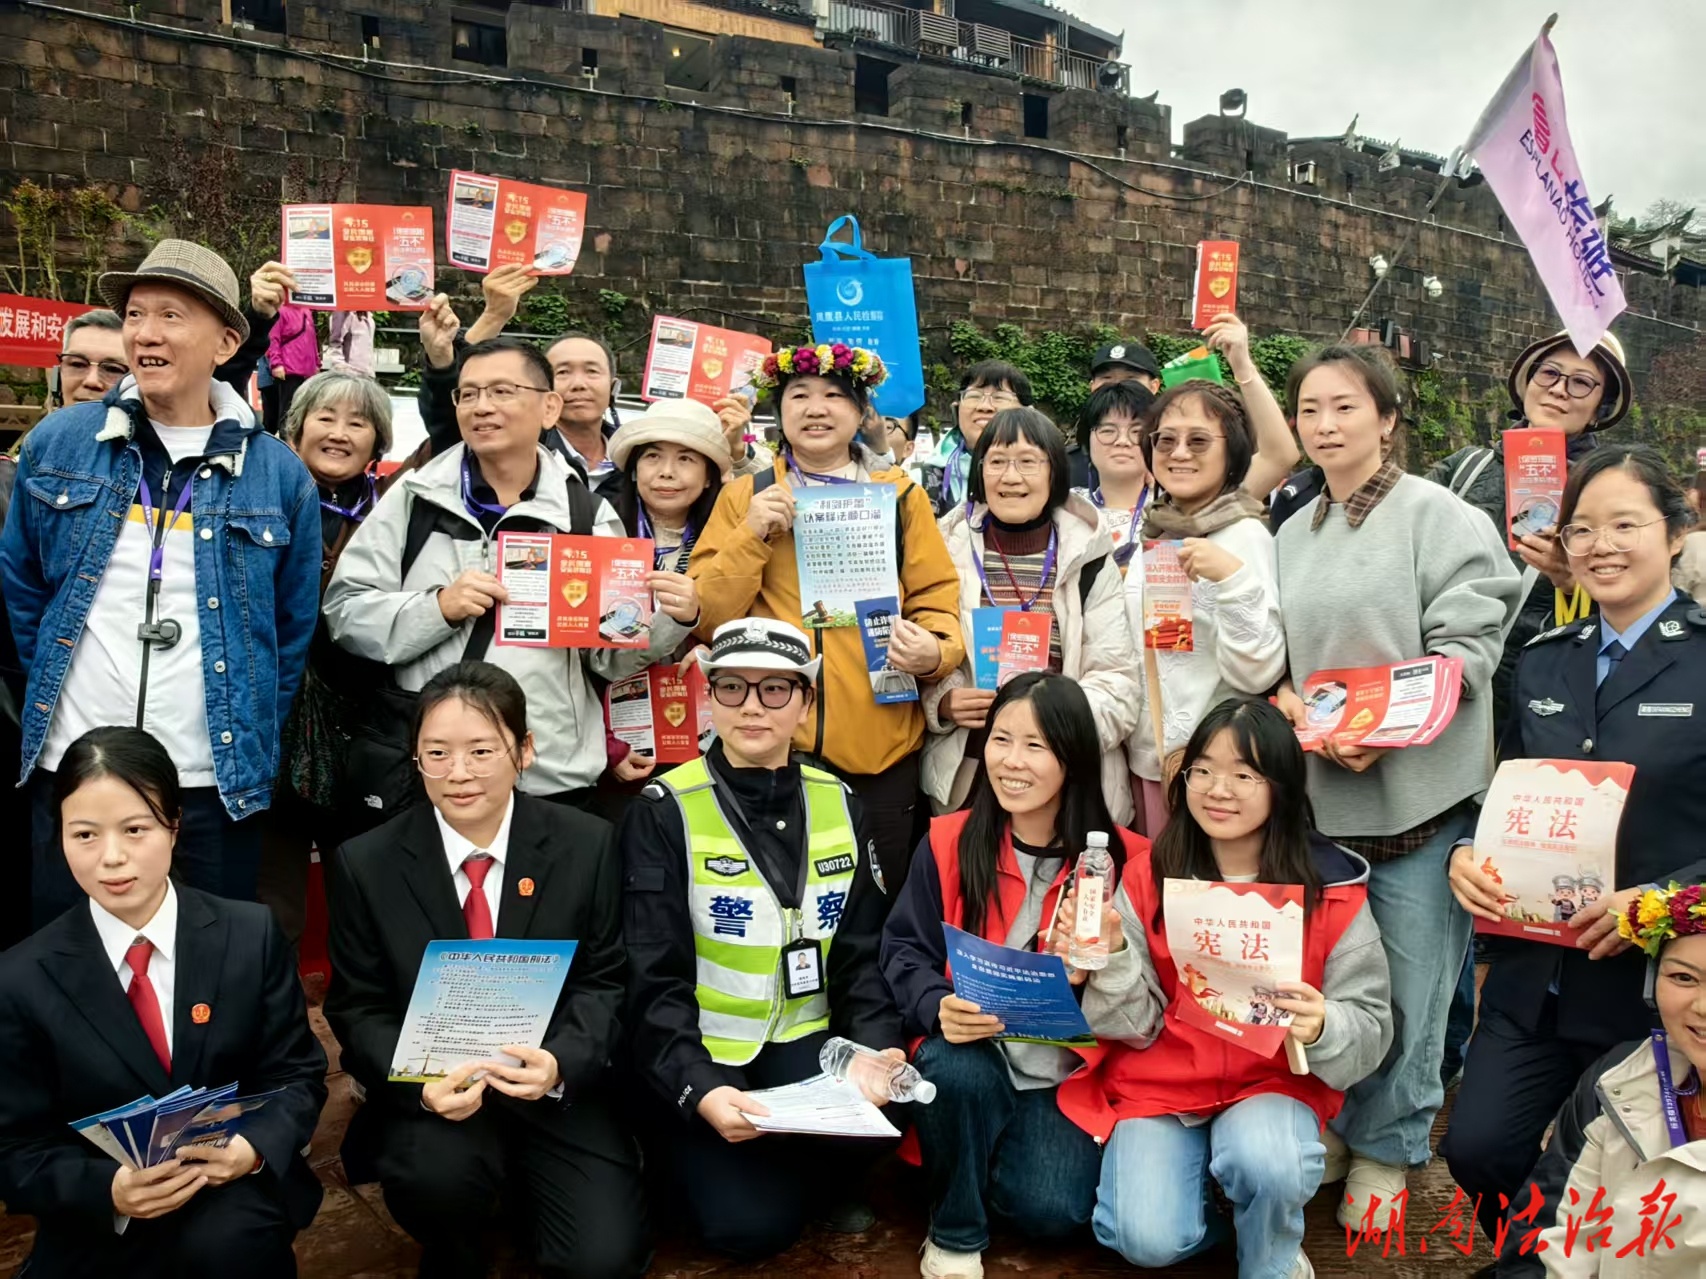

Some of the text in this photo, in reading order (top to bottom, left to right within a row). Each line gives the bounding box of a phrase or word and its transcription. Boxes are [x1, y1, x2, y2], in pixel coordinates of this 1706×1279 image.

[1512, 794, 1586, 807] 中华人民共和国
[1504, 806, 1578, 841] 宪法
[817, 857, 852, 873] U30722
[708, 890, 847, 938] 警 察
[1193, 918, 1271, 930] 中华人民共和国
[1193, 930, 1270, 962] 宪法
